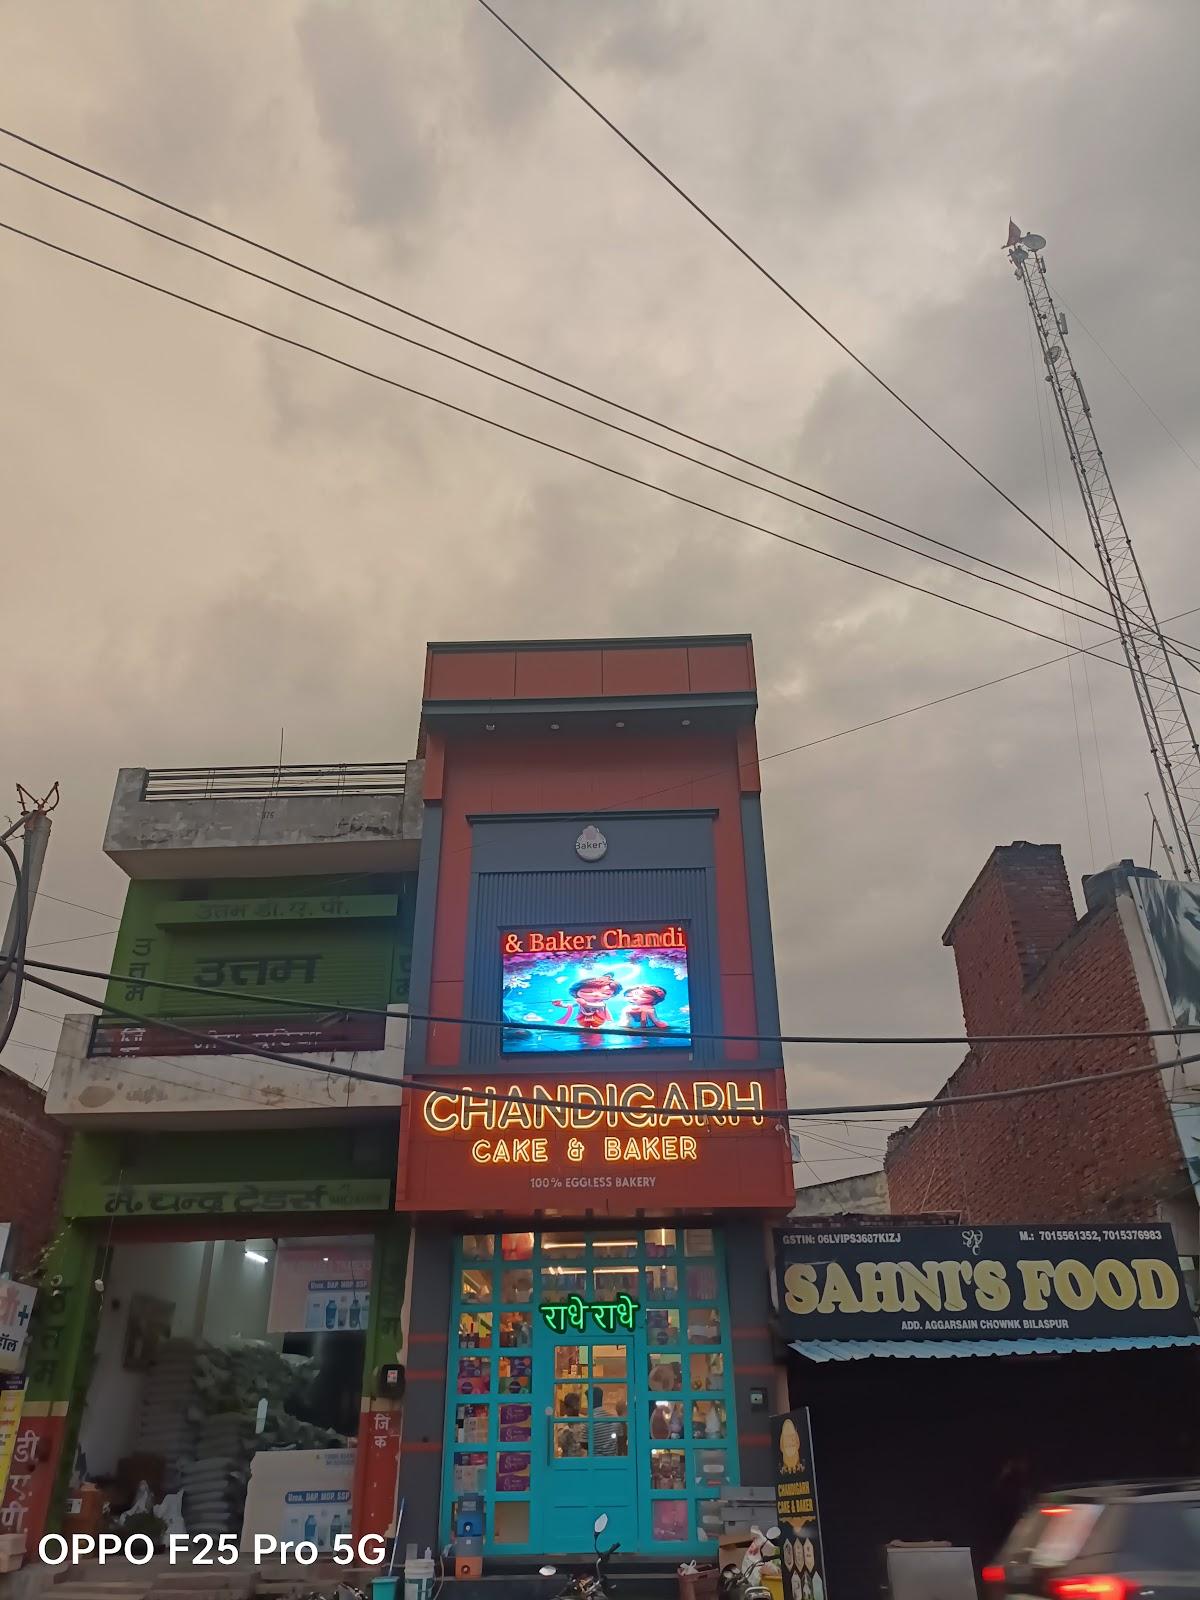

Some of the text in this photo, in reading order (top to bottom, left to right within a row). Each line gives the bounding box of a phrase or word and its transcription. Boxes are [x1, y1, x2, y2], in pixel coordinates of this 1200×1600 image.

[505, 933, 523, 953] &
[530, 931, 596, 951] Baker
[193, 954, 323, 987] उत्तम
[423, 1081, 763, 1131] CHANDIGARH
[472, 1136, 697, 1164] CAKE & BAKER
[530, 1176, 656, 1188] 100% EGGLESS BAKERY
[782, 1234, 815, 1245] GSTIN:
[1039, 1231, 1101, 1242] 7015561352,
[1102, 1231, 1162, 1240] 7015376983
[784, 1258, 1180, 1313] SAHNI'S FOOD
[541, 1295, 638, 1329] राधे राधे
[902, 1319, 1069, 1330] ADD. AGGARSAIN CHOWNK BILASPUR
